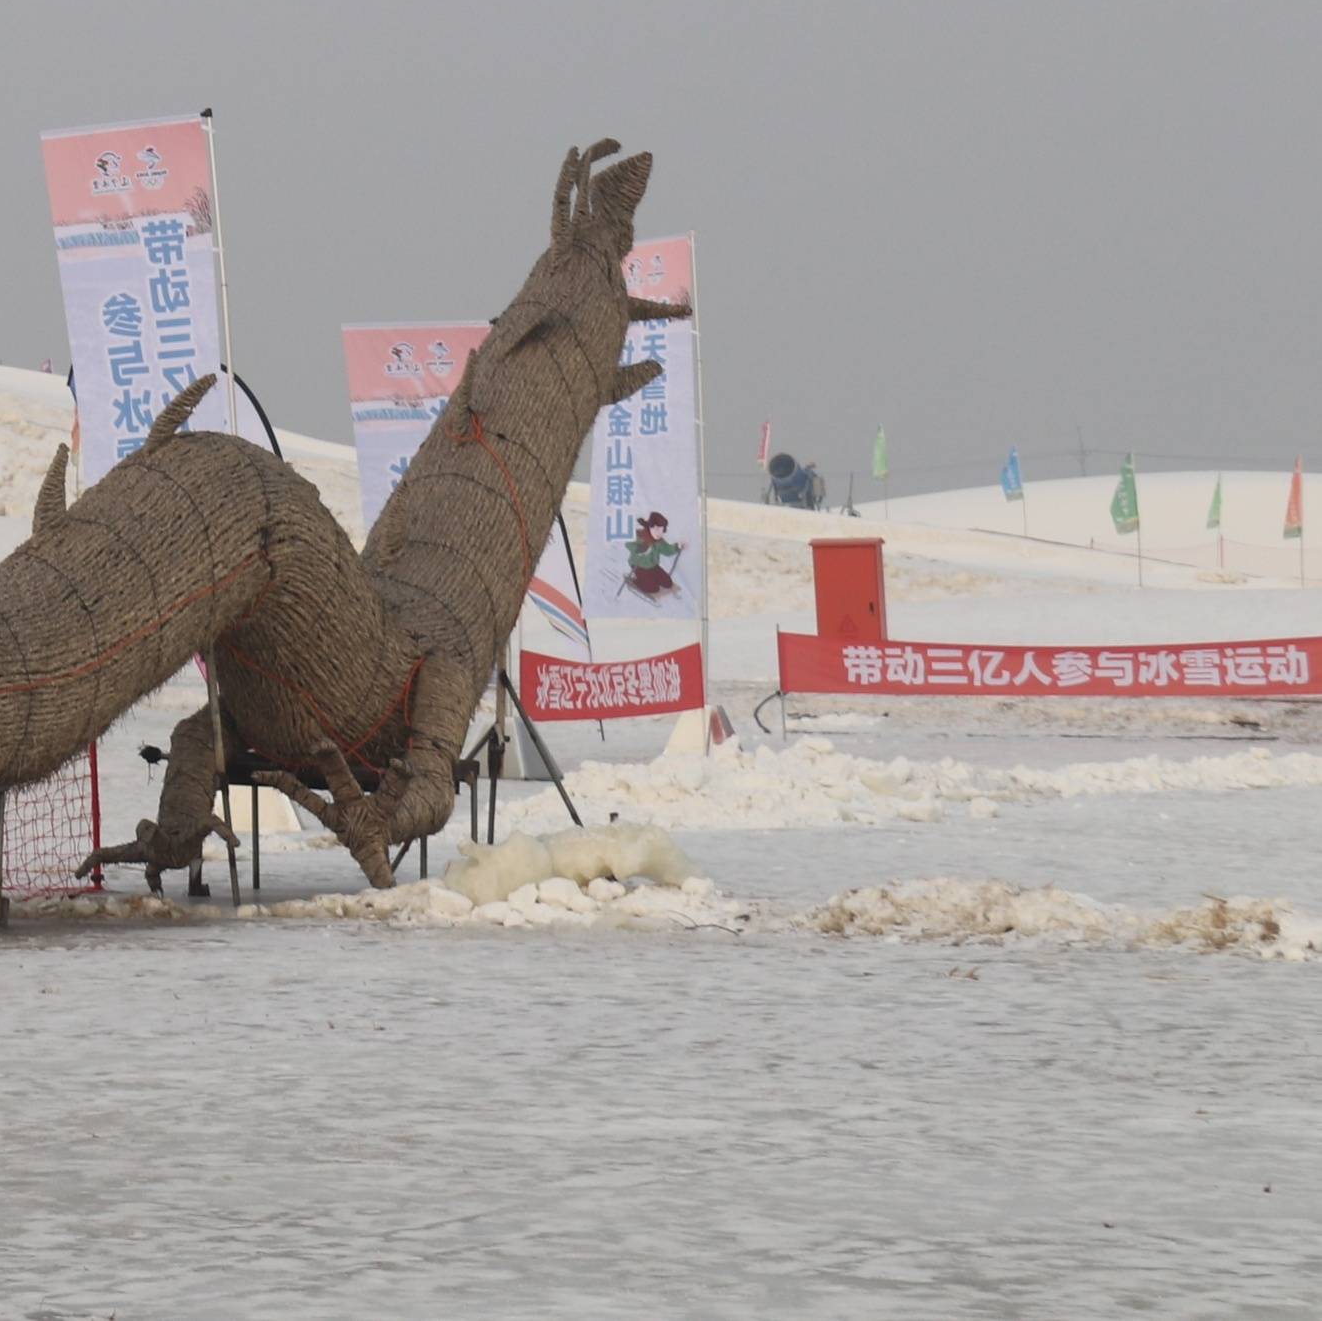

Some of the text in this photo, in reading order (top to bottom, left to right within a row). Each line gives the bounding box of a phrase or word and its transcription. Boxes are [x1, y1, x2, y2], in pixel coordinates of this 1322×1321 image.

[842, 645, 1309, 686] 带动三亿人参与冰雪运动
